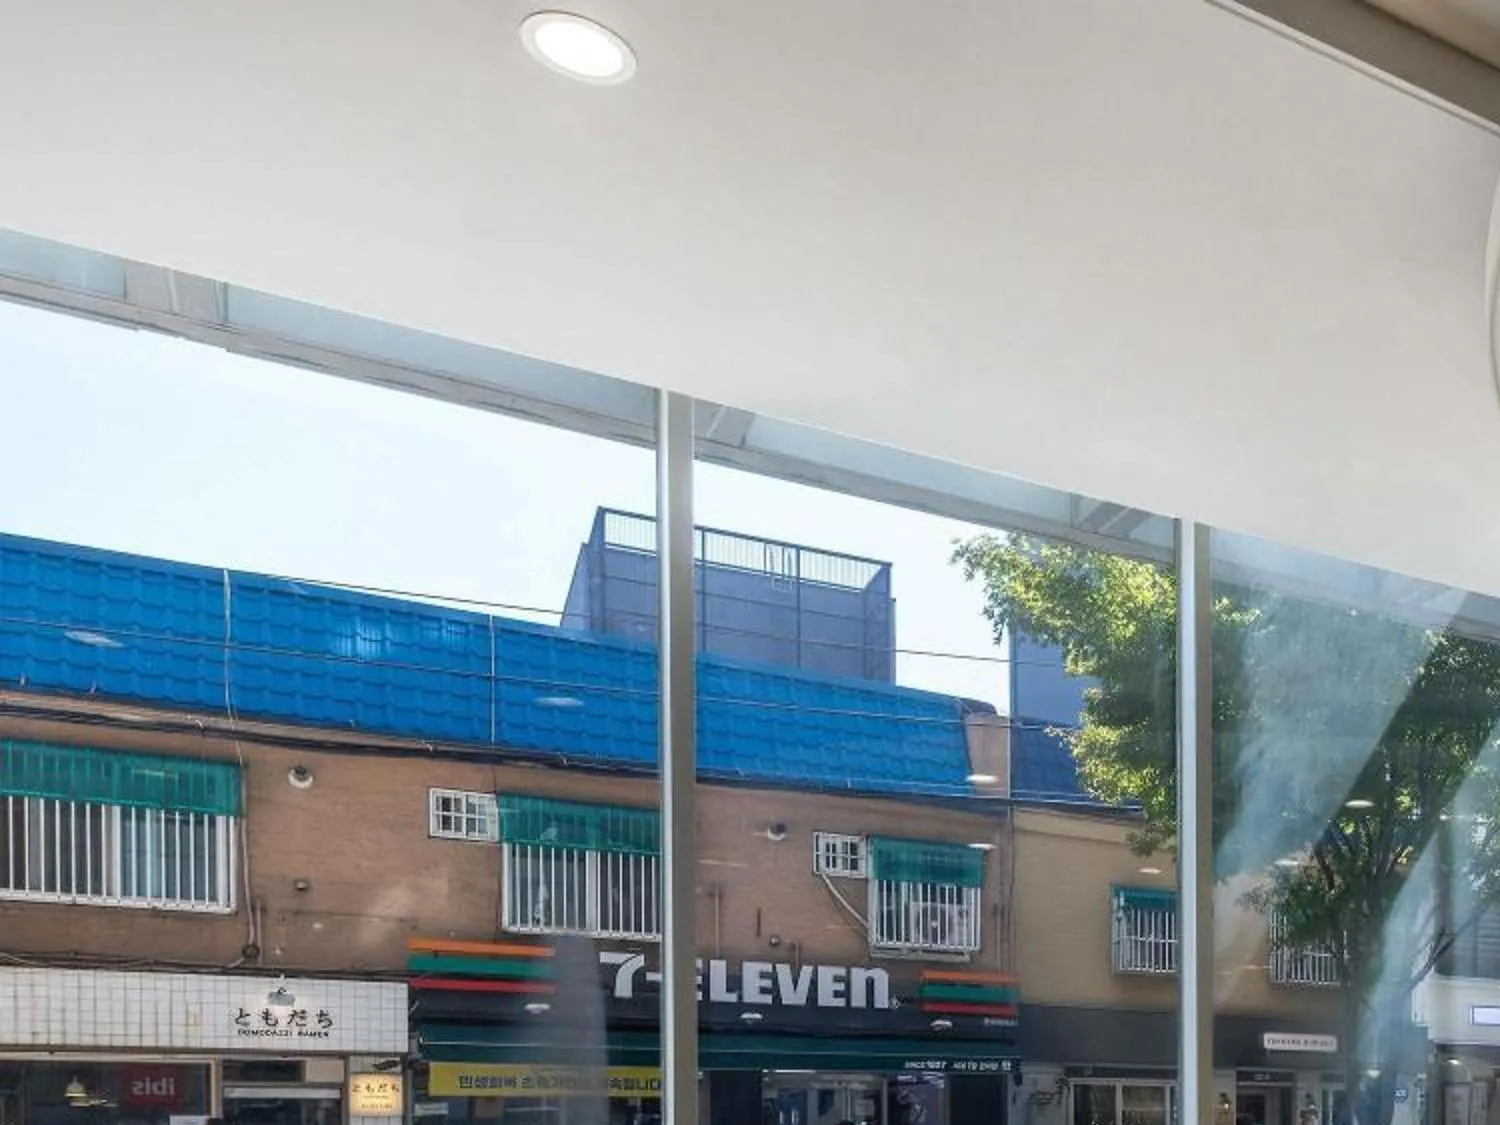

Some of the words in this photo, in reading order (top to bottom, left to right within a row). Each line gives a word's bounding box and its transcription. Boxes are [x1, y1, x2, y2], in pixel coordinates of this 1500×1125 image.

[600, 951, 889, 1009] 7-LEVEn
[235, 1008, 333, 1029] ともだち
